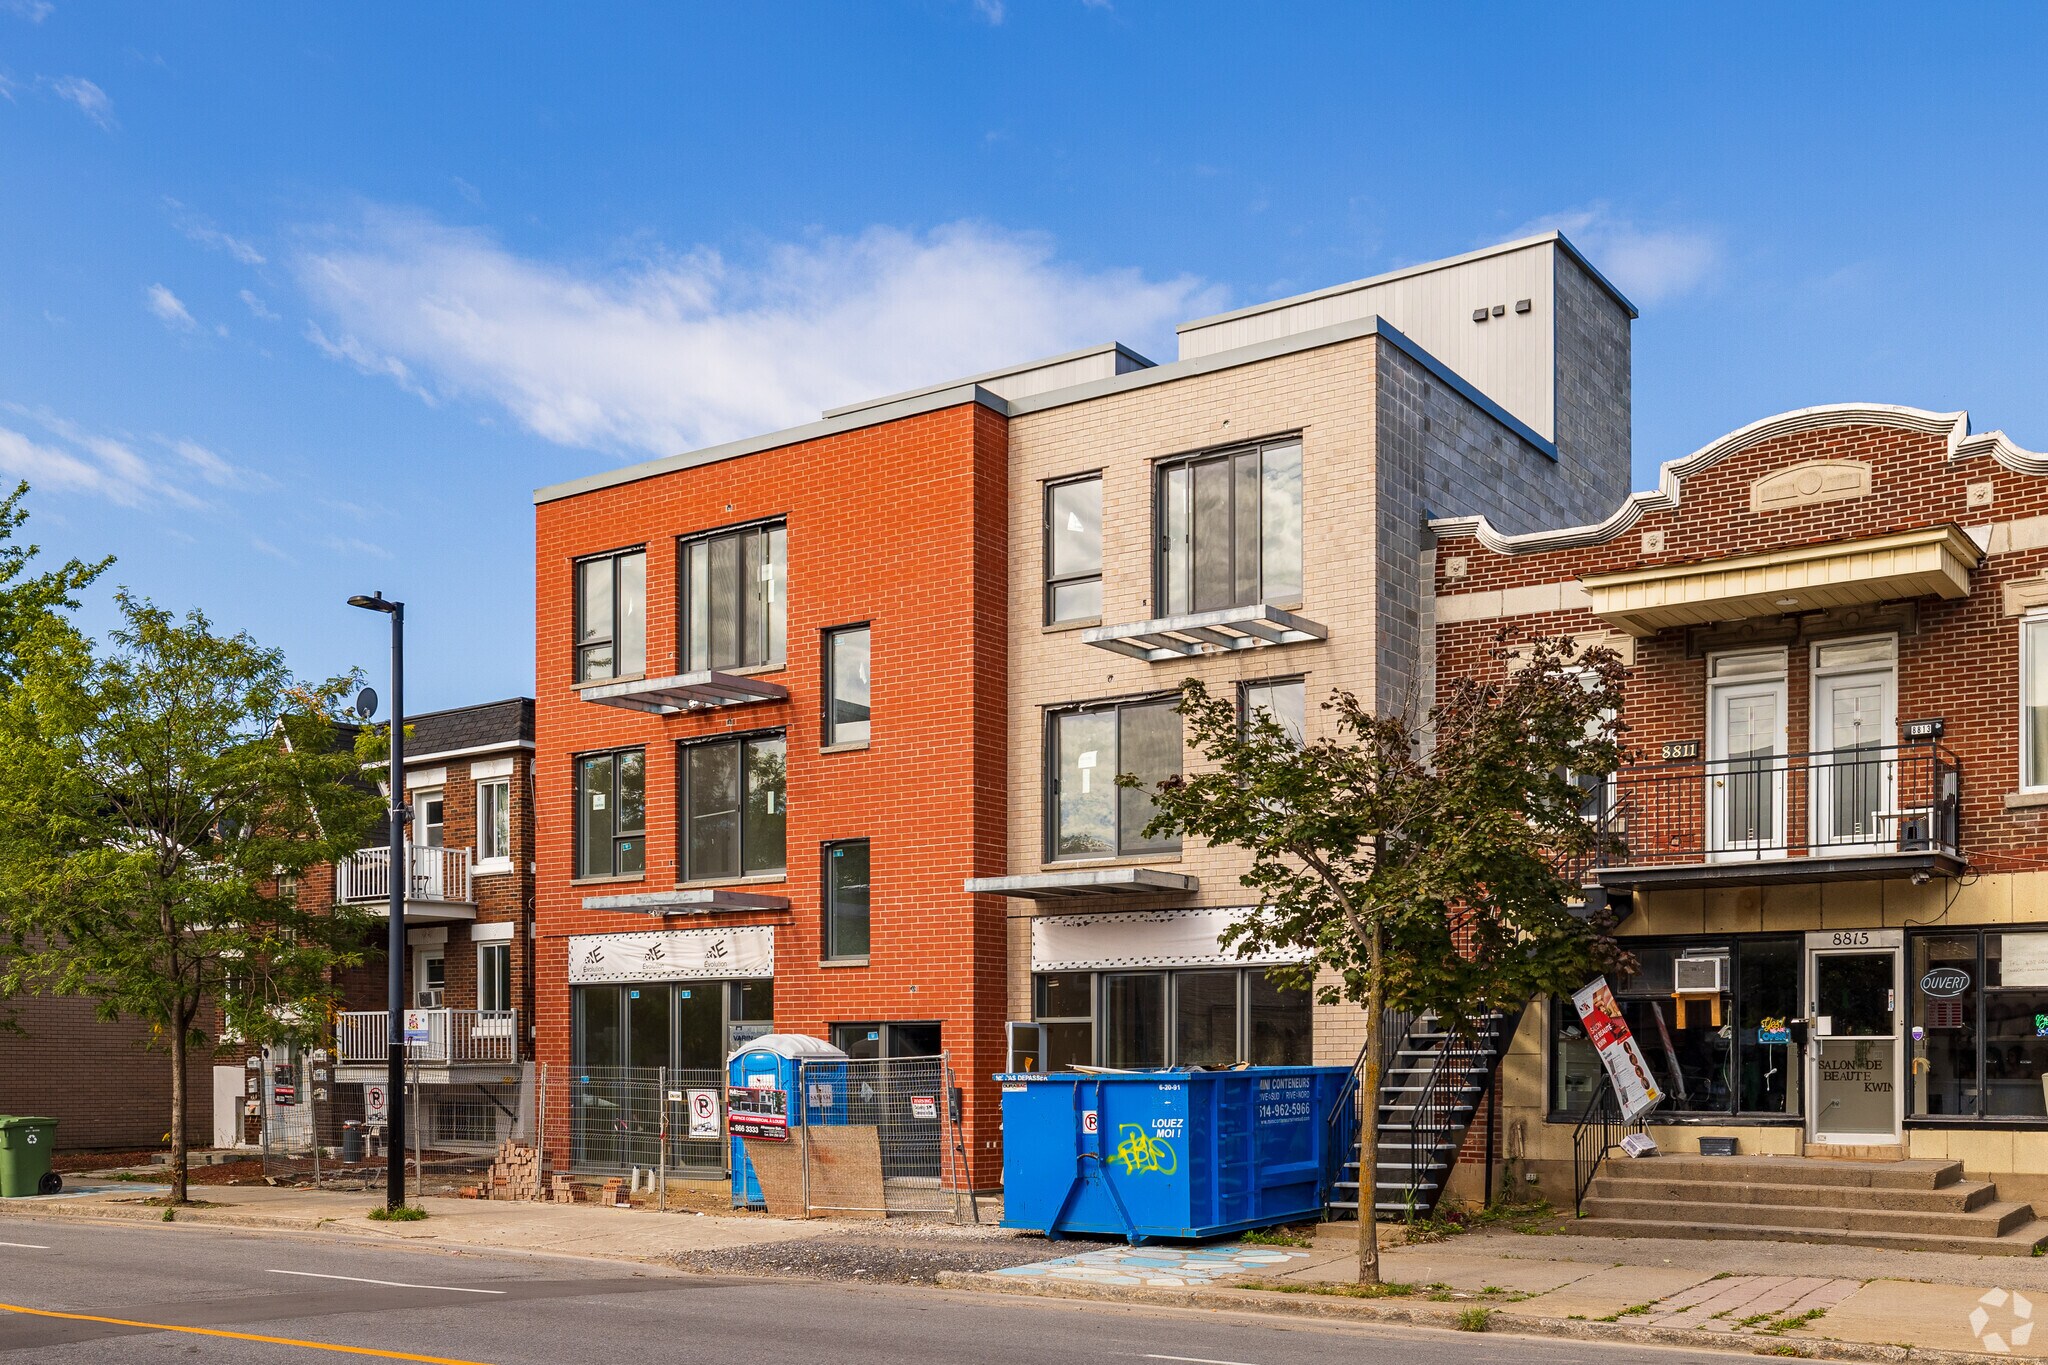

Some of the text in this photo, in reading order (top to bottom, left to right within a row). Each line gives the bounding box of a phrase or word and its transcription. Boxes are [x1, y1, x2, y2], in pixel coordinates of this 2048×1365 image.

[1911, 725, 1931, 734] 8813
[1661, 744, 1696, 759] 8811
[1832, 932, 1869, 946] 8815
[1922, 976, 1967, 990] OUVERT
[1818, 1060, 1883, 1070] SALON DE
[1823, 1071, 1872, 1081] BEAUTE
[1272, 1078, 1310, 1089] CONTENEURS
[1152, 1119, 1184, 1128] LOUEZ
[1156, 1129, 1175, 1138] MOI
